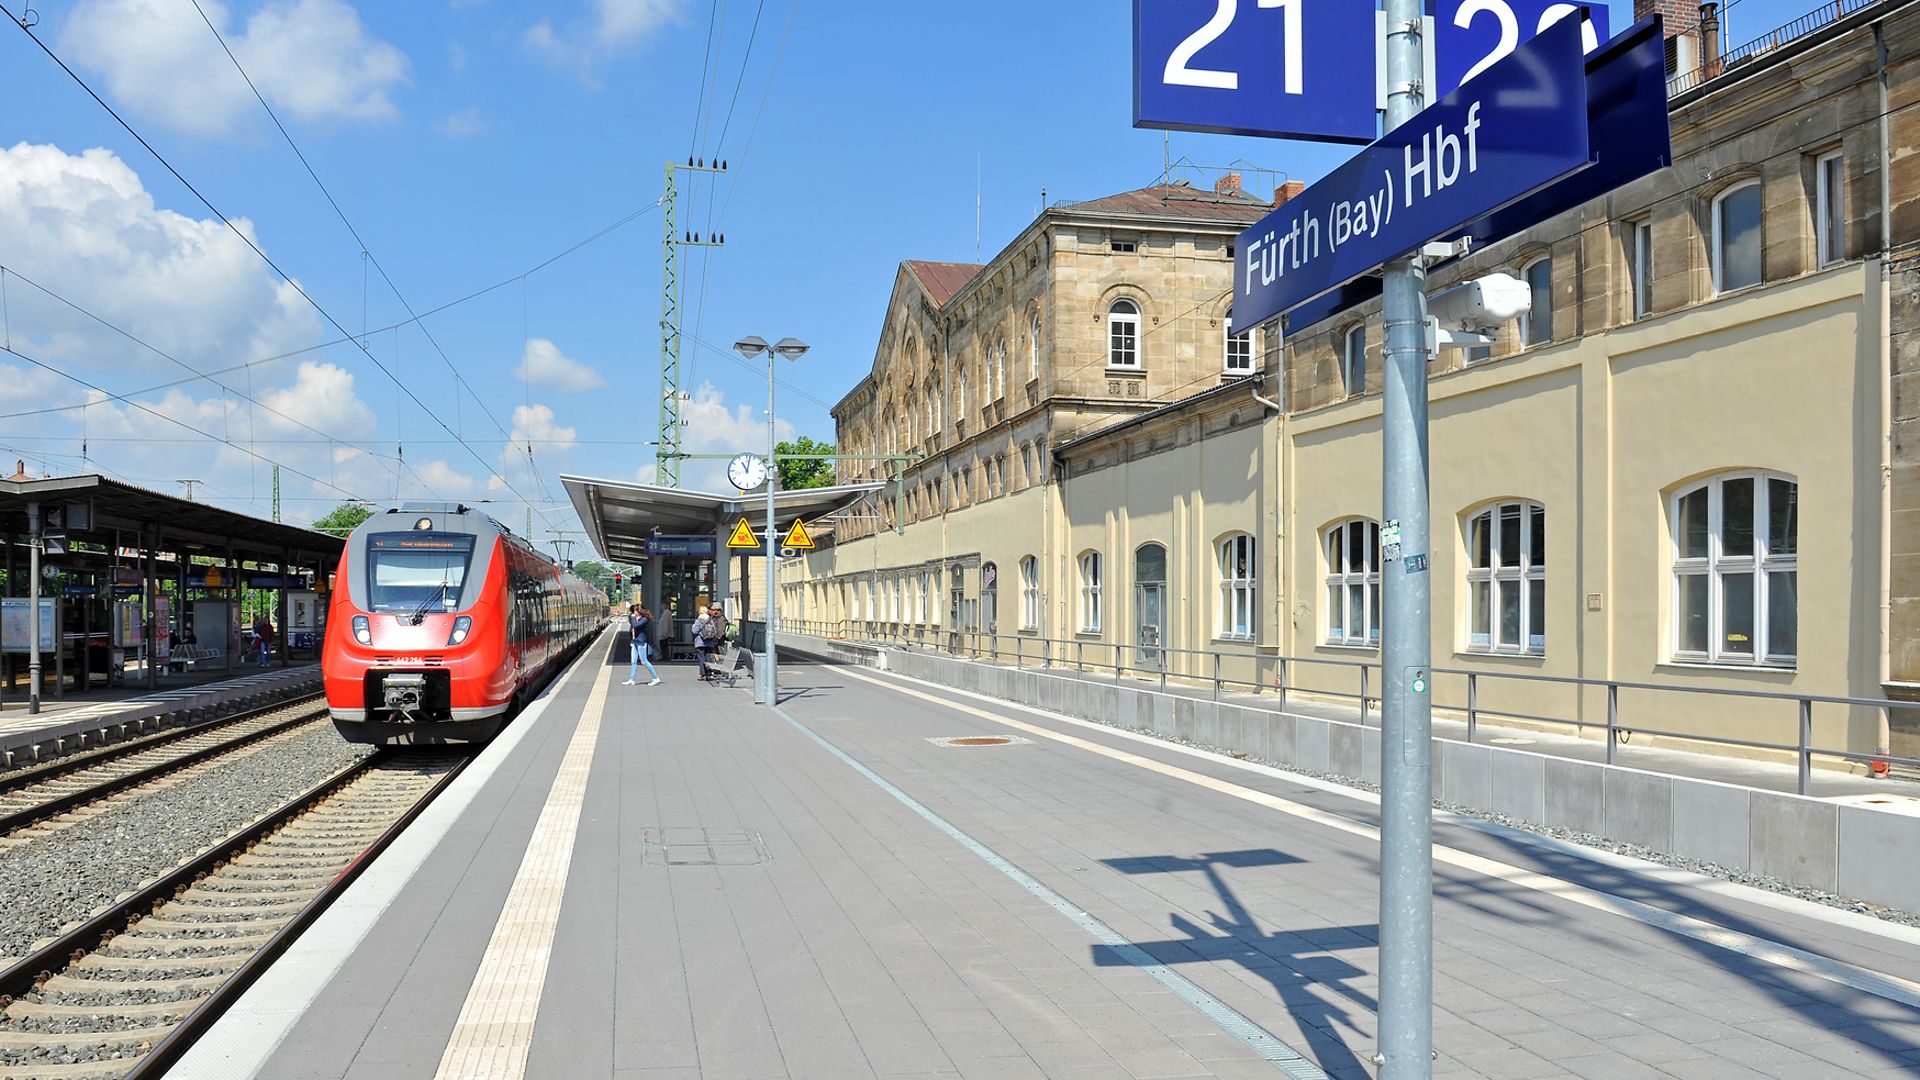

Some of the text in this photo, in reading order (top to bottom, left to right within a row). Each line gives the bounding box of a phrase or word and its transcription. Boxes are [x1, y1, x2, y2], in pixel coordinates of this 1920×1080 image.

[1163, 0, 1303, 95] 21
[1245, 101, 1481, 296] Fürth (Bay) Hbf
